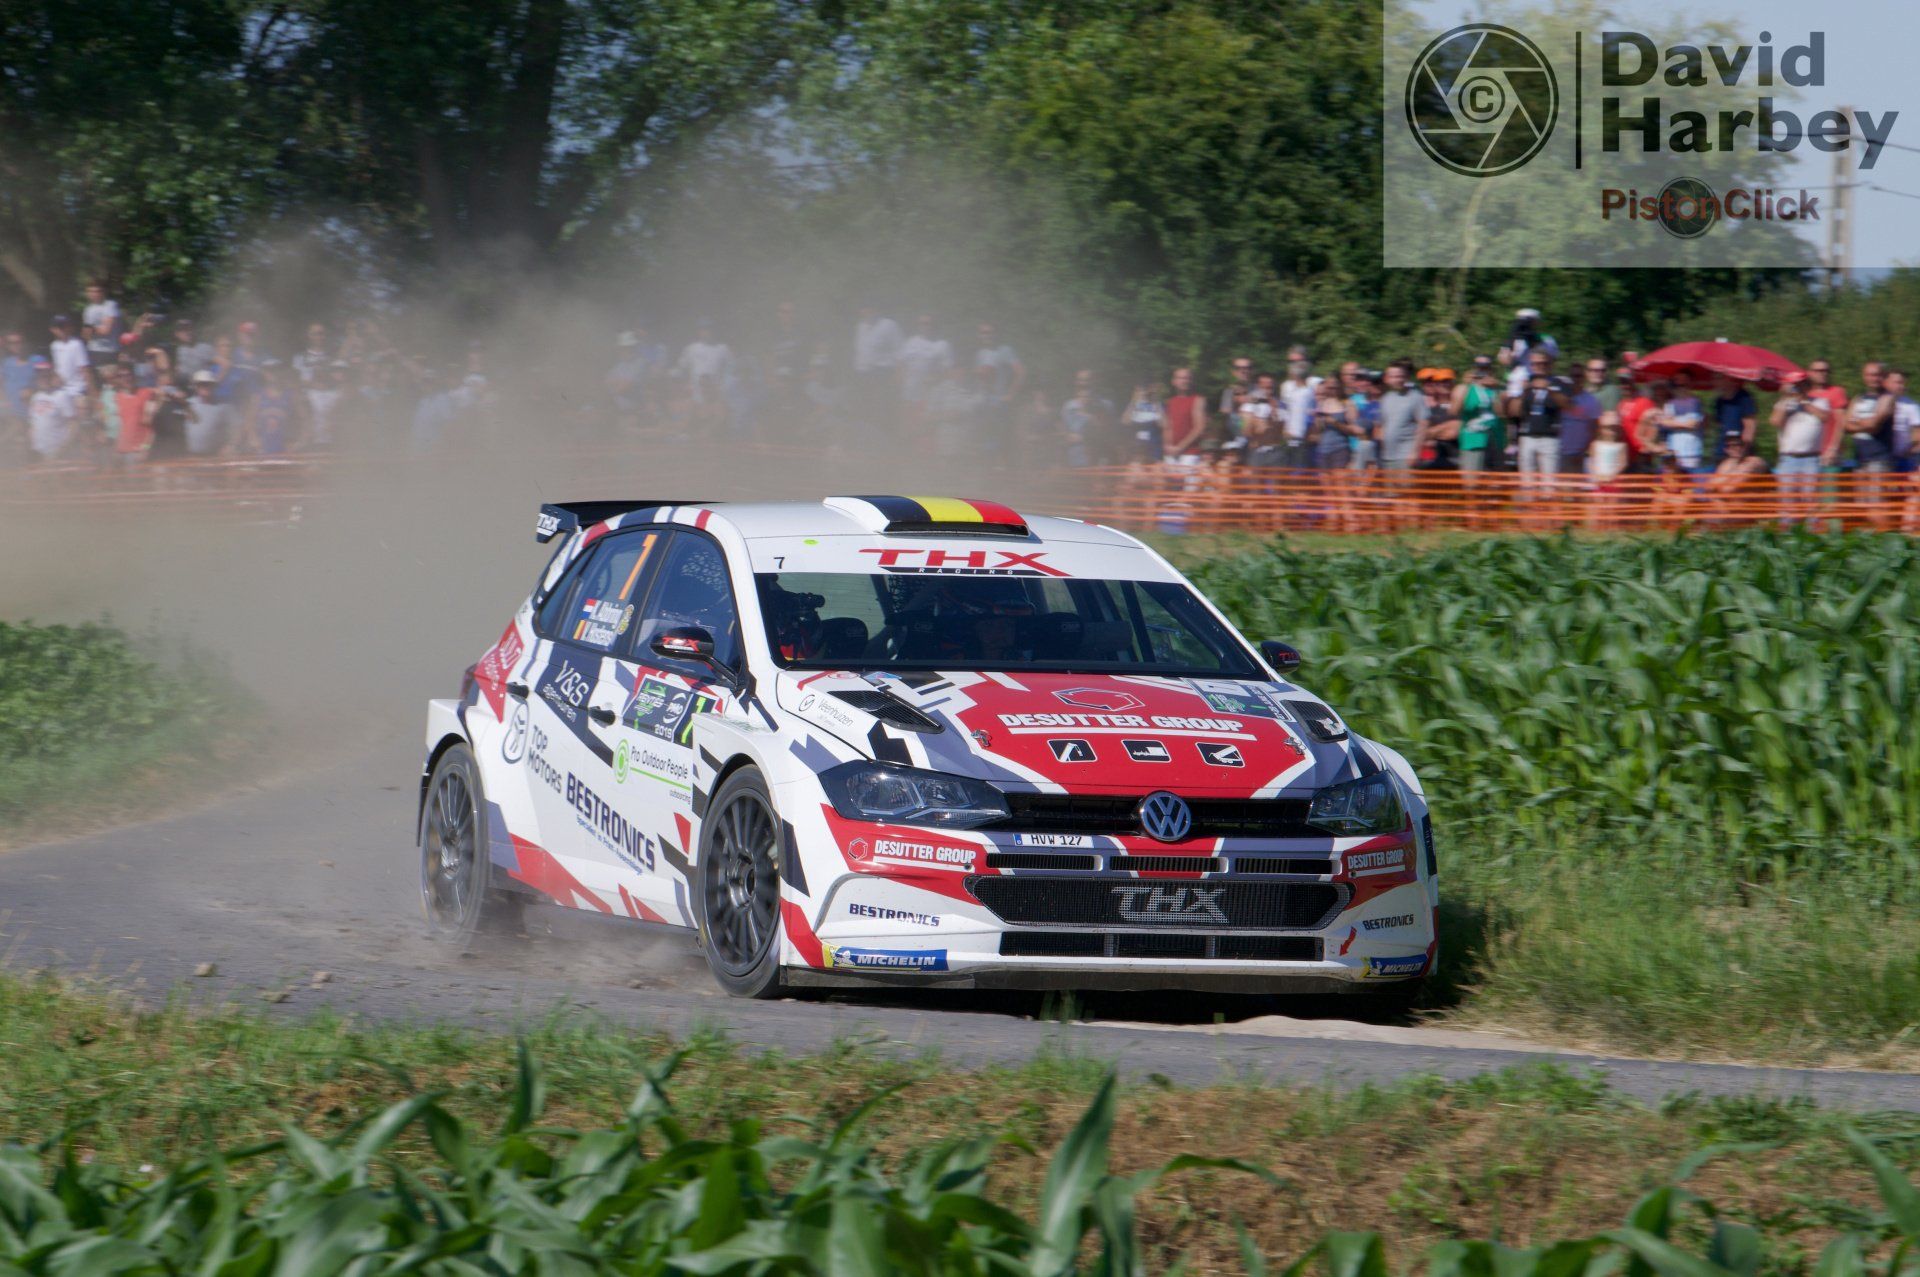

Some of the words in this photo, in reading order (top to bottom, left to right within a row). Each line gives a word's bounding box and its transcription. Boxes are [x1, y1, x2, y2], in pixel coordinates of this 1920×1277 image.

[619, 535, 658, 600] 1
[773, 556, 785, 570] 7
[859, 549, 1073, 577] THX
[662, 637, 699, 652] TX
[555, 660, 589, 707] V&S
[654, 723, 673, 738] 2019
[997, 713, 1146, 729] DESUTTER
[1150, 715, 1244, 732] GROUP
[532, 725, 548, 750] TOP
[631, 745, 641, 763] Pro
[527, 749, 562, 794] MOTORS
[566, 771, 656, 873] BESTRONICS
[1031, 834, 1057, 846] HVW
[1060, 834, 1082, 847] 127
[874, 839, 934, 861] DESUTTER
[936, 846, 977, 864] GROUP
[1347, 851, 1386, 870] DESUTTER
[1110, 886, 1229, 924] THX
[849, 903, 941, 927] BESTRONICS
[1362, 913, 1415, 930] BESTRONICS
[857, 954, 936, 967] MICHELIN
[1382, 960, 1425, 974] MICHELIN
